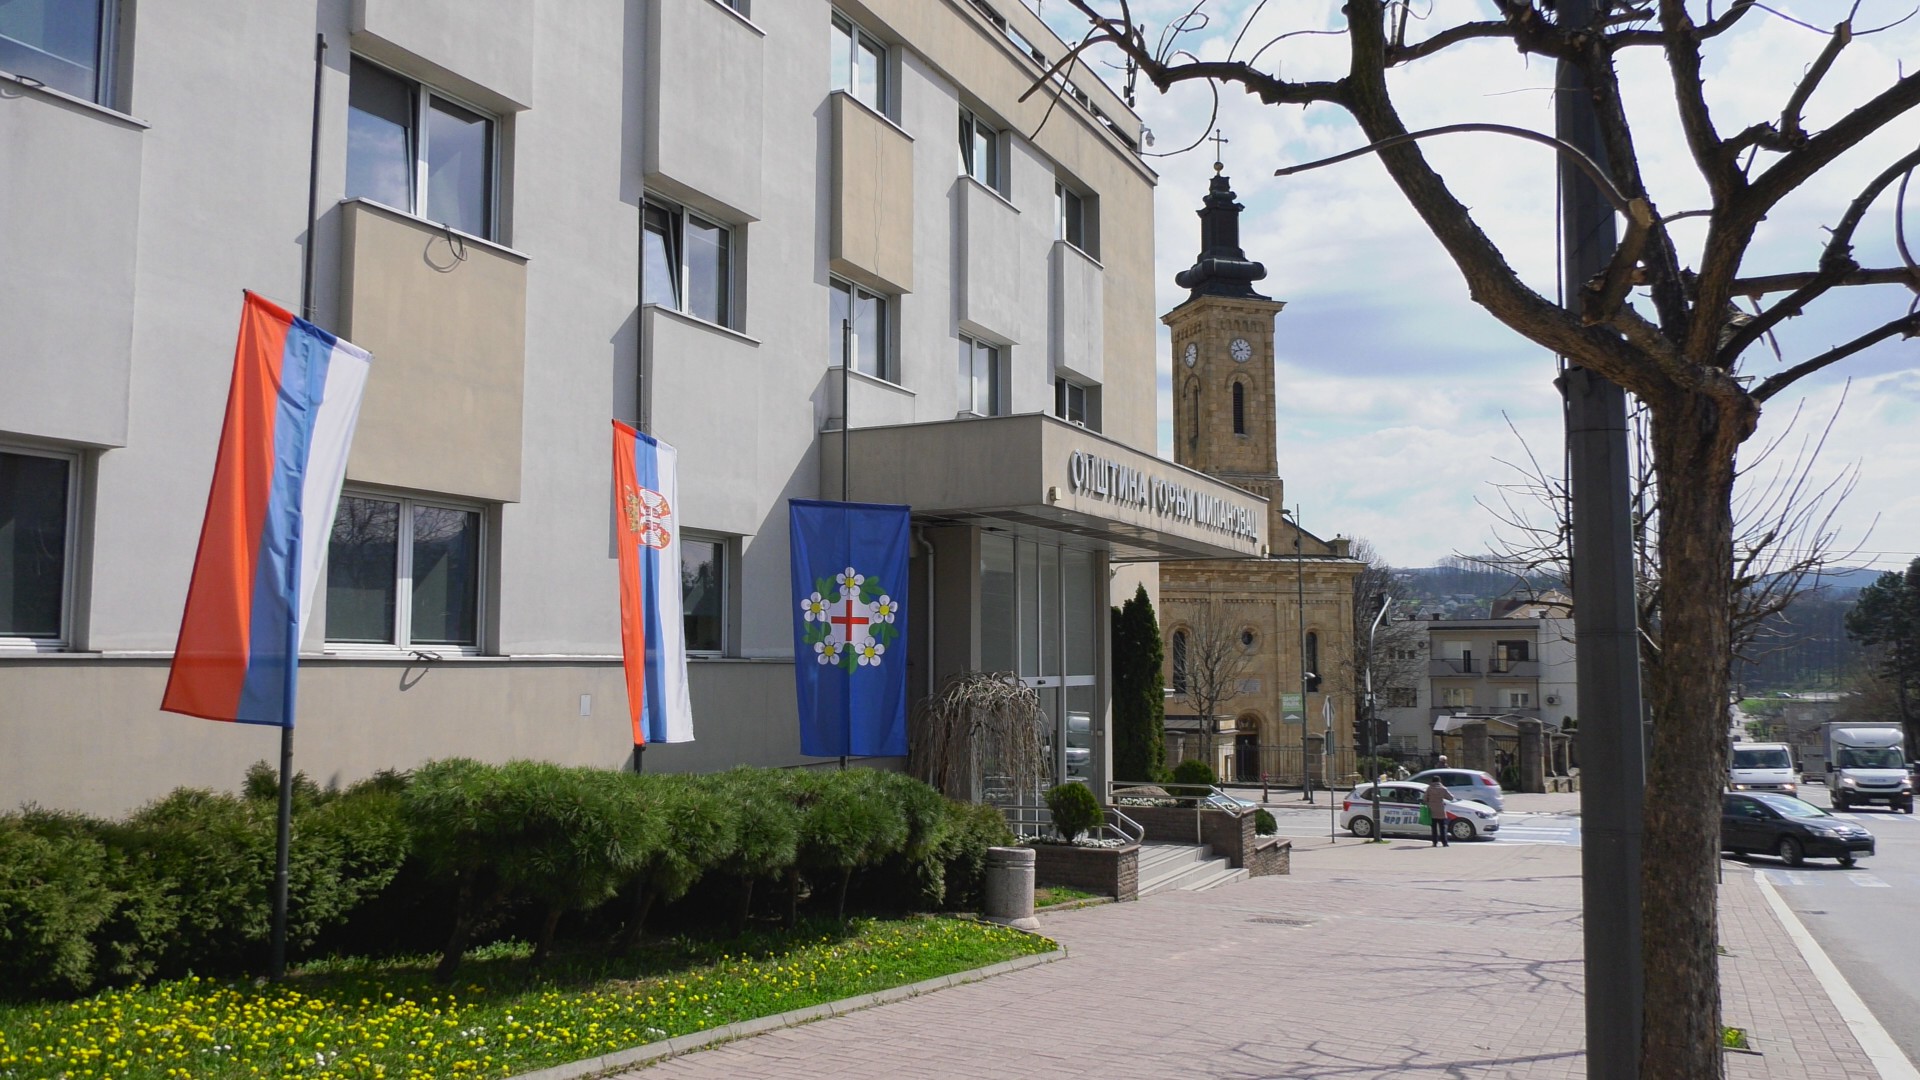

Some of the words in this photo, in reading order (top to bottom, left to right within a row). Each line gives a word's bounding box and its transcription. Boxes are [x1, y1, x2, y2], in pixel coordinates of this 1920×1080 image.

[1071, 449, 1147, 506] ОПШТИНА
[1152, 475, 1195, 520] ГОРЊИ
[1197, 491, 1258, 540] МИЛАНОВАЦ
